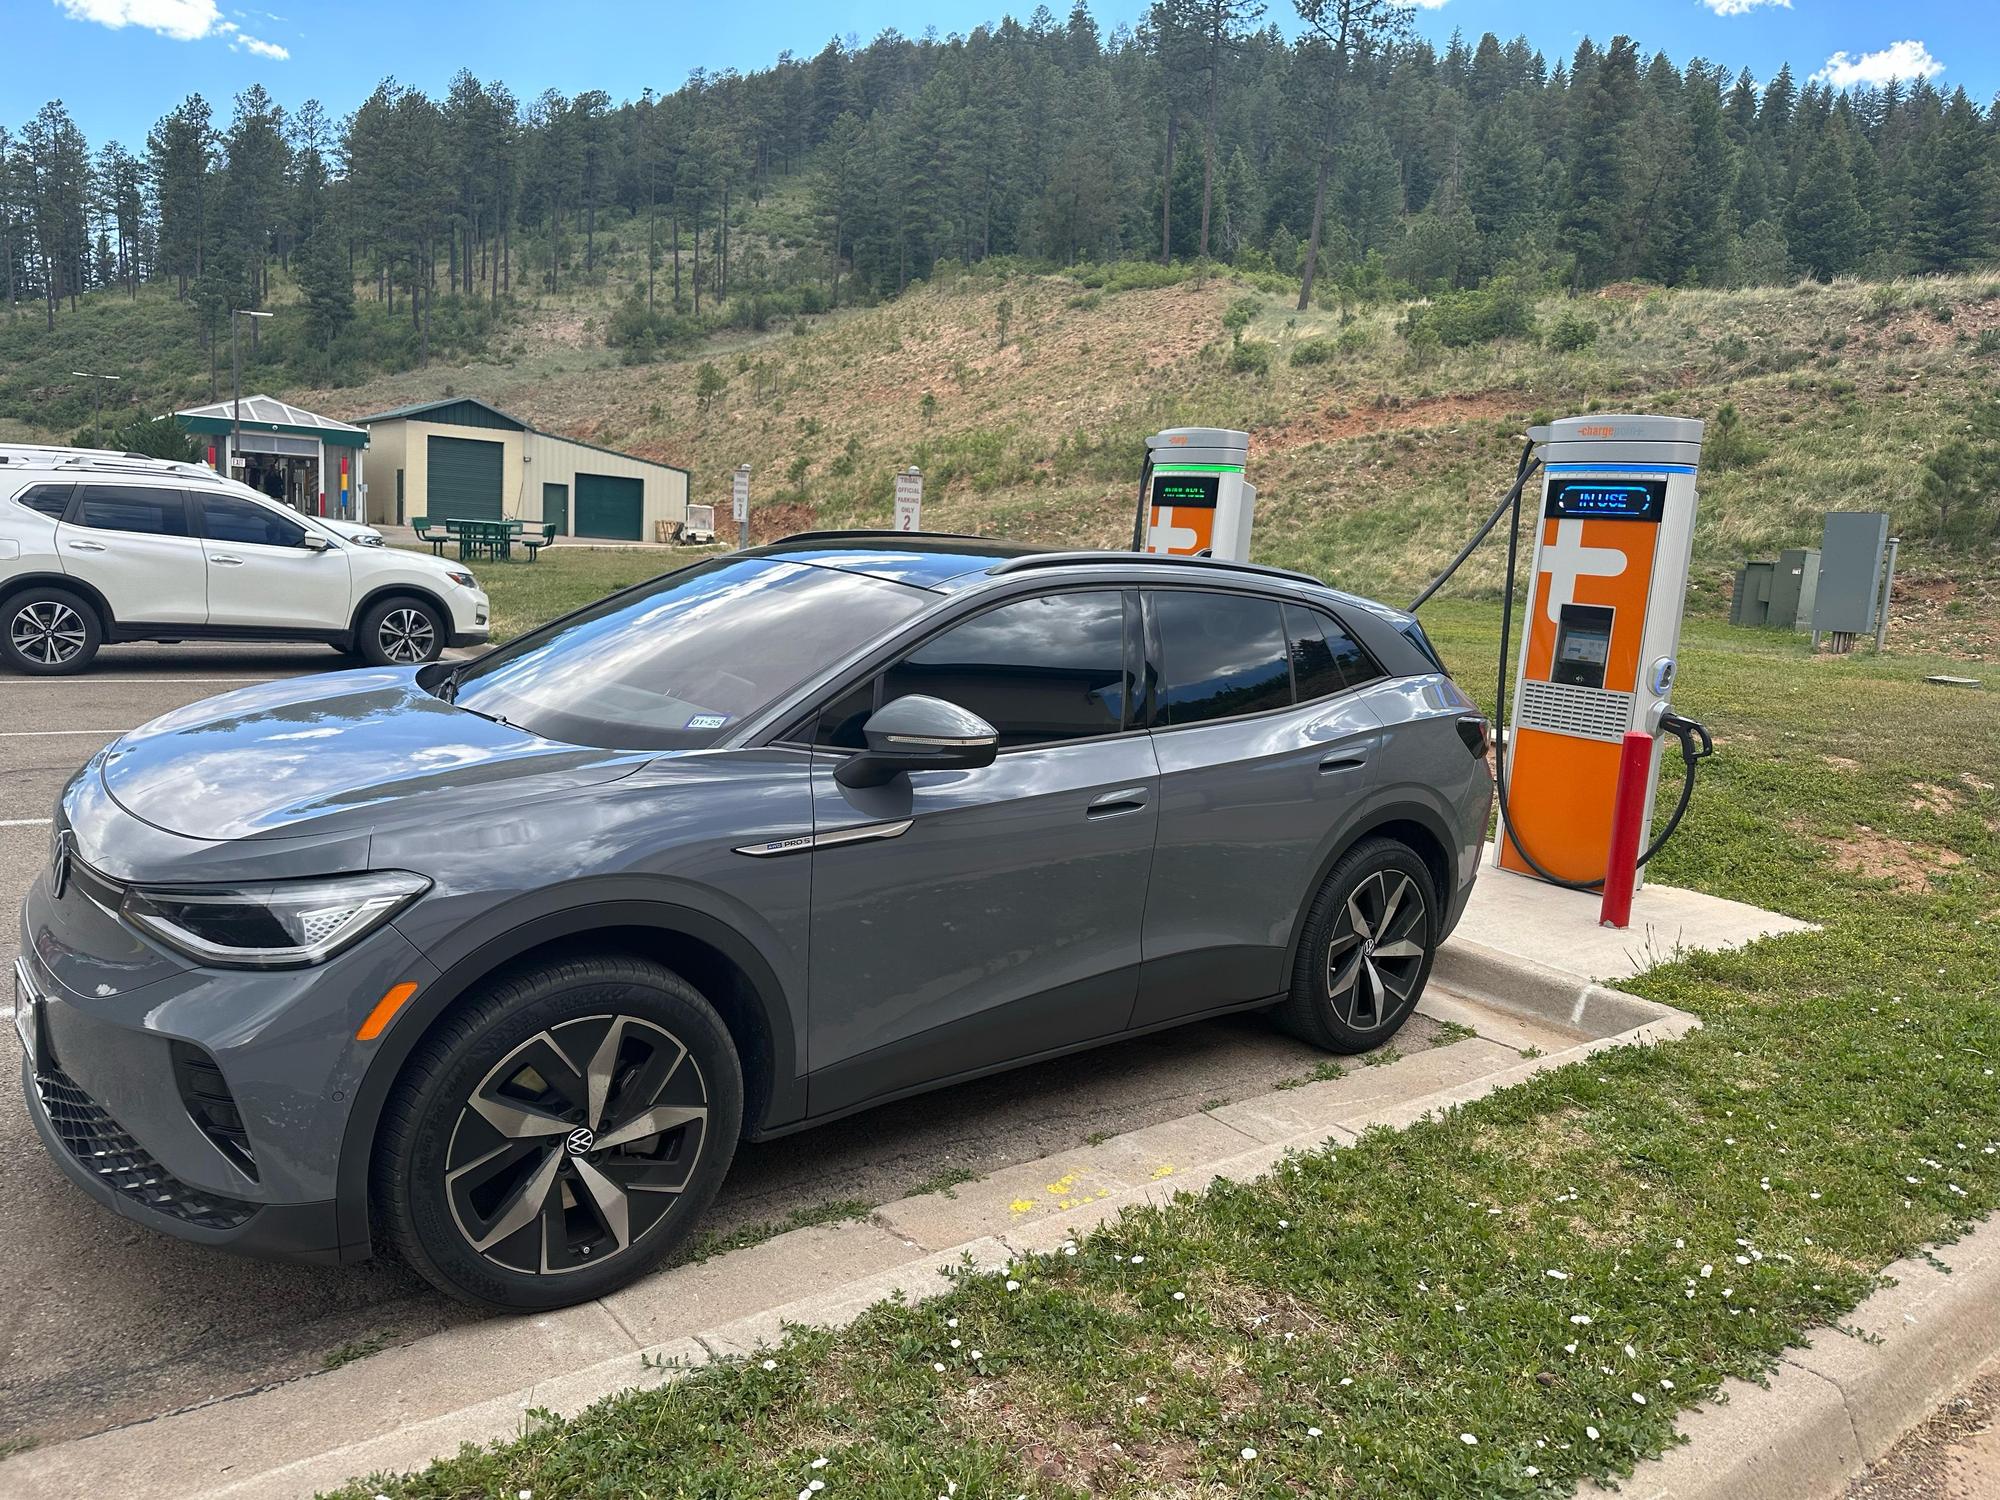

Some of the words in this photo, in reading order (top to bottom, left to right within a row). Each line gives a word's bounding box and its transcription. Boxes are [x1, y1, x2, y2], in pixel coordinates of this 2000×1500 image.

[1579, 493, 1595, 507] IN
[1598, 494, 1628, 508] USE
[903, 514, 911, 530] 2
[784, 839, 803, 847] PRO
